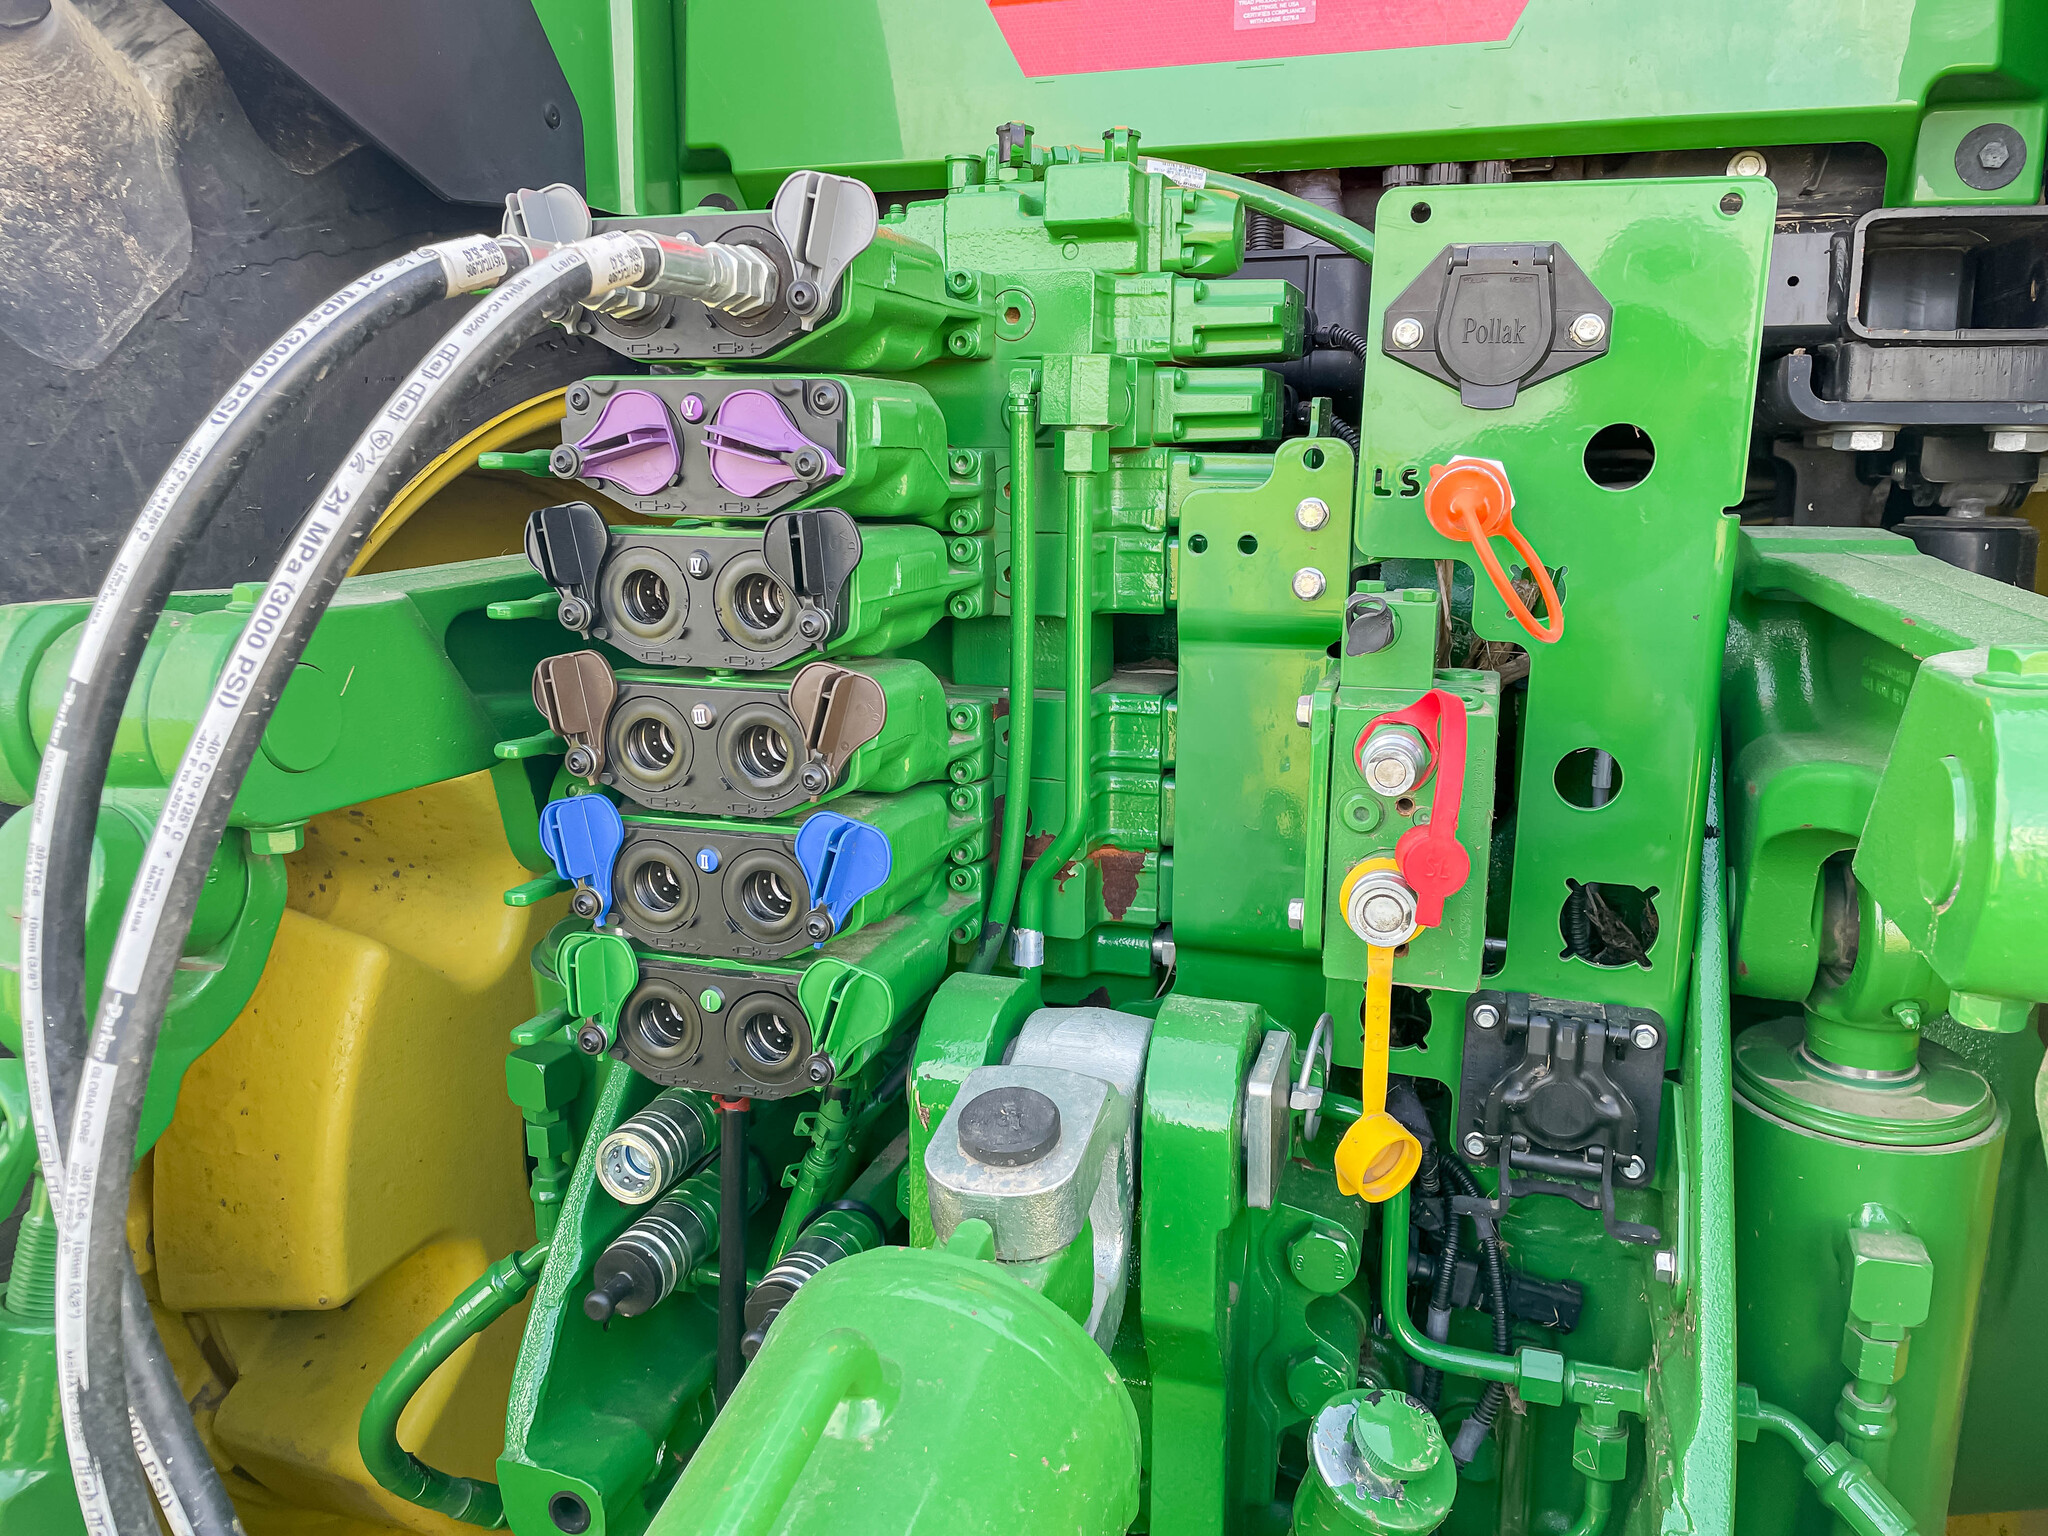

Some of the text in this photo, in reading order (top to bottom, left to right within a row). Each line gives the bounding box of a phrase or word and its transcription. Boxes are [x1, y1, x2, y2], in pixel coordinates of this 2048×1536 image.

[1461, 317, 1528, 345] Pollak
[208, 382, 253, 424] PSI)
[683, 399, 695, 416] V
[1373, 467, 1421, 497] LS
[218, 486, 350, 708] 21 MPa (3000 PSI)
[94, 1002, 124, 1061] Parker
